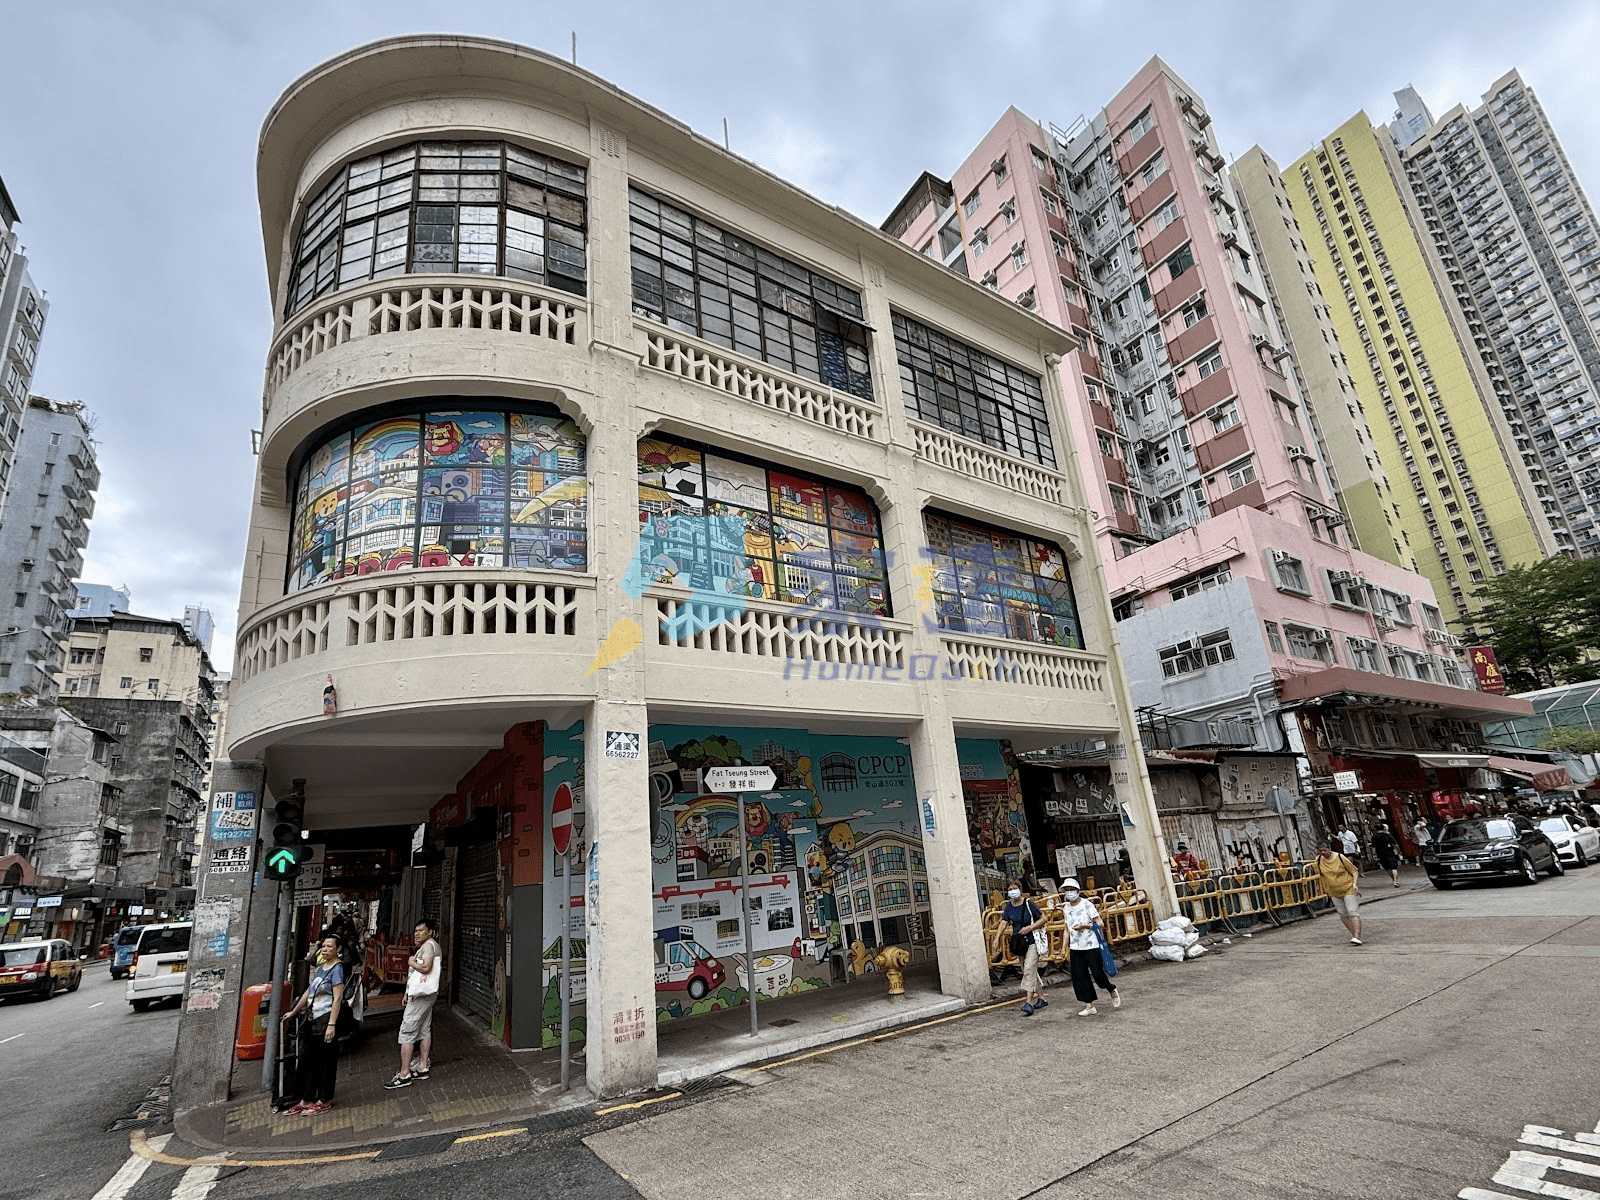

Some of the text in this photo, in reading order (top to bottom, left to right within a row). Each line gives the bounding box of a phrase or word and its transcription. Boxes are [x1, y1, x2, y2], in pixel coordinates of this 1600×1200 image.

[605, 750, 639, 759] 66562227
[857, 755, 906, 775] CPCP
[711, 769, 723, 777] Fat
[725, 769, 748, 778] Tseung
[729, 780, 756, 789] 發祥街
[216, 793, 233, 809] 補
[212, 830, 253, 840] 51192712
